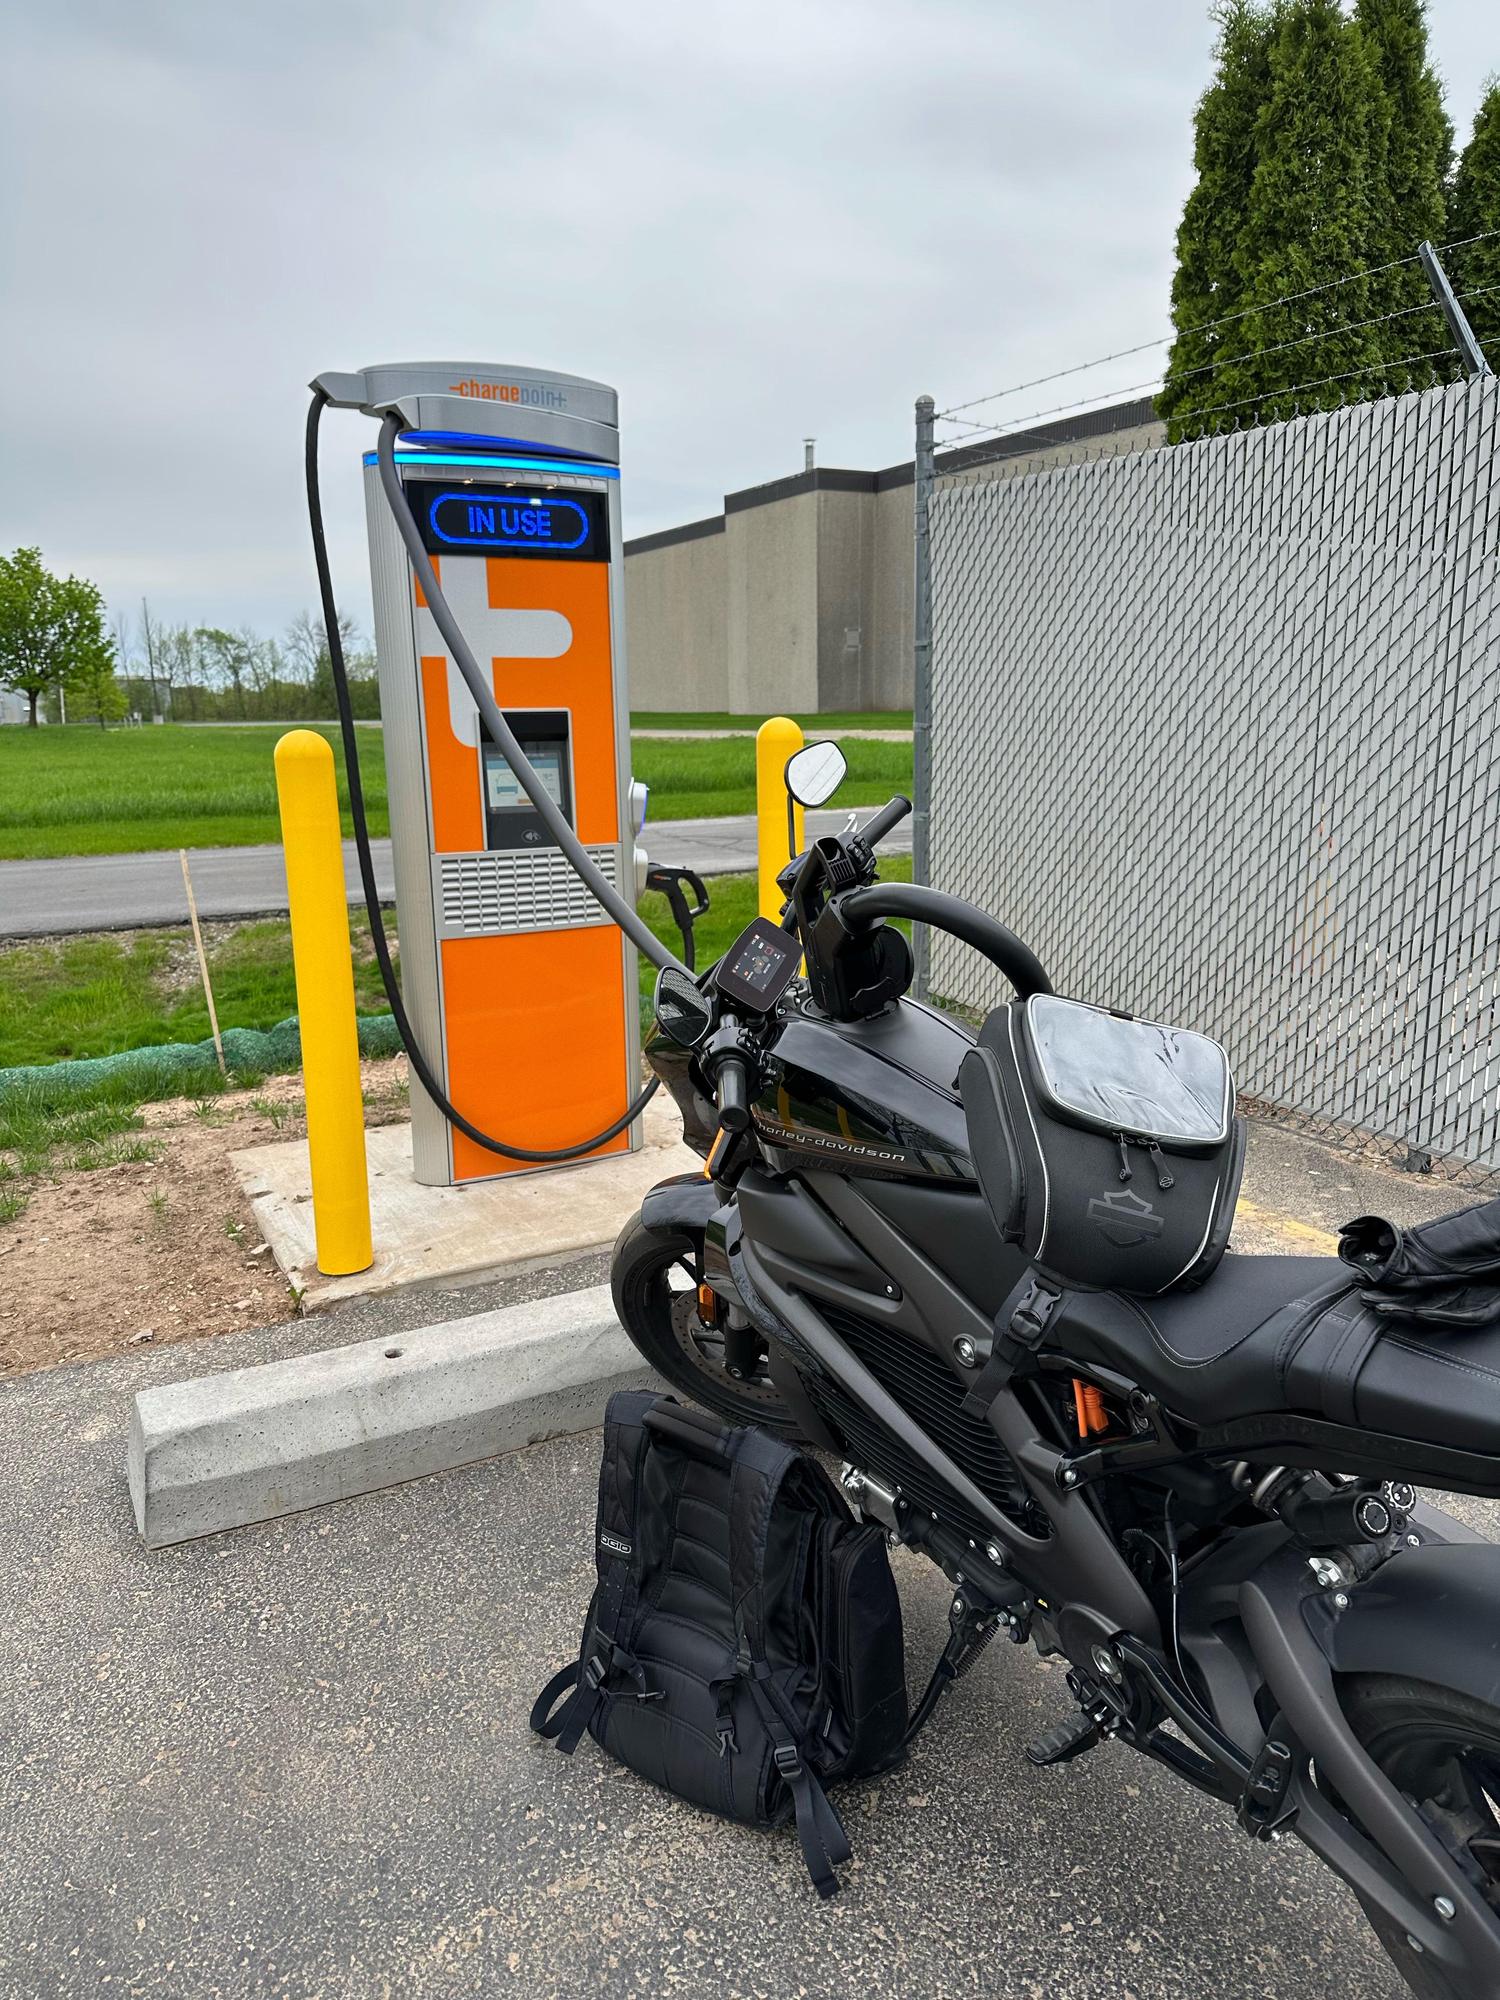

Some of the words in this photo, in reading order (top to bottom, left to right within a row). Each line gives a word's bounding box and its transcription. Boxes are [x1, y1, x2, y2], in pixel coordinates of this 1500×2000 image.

[468, 505, 495, 534] IN
[501, 508, 552, 537] USE
[758, 1121, 905, 1162] harley-davidson
